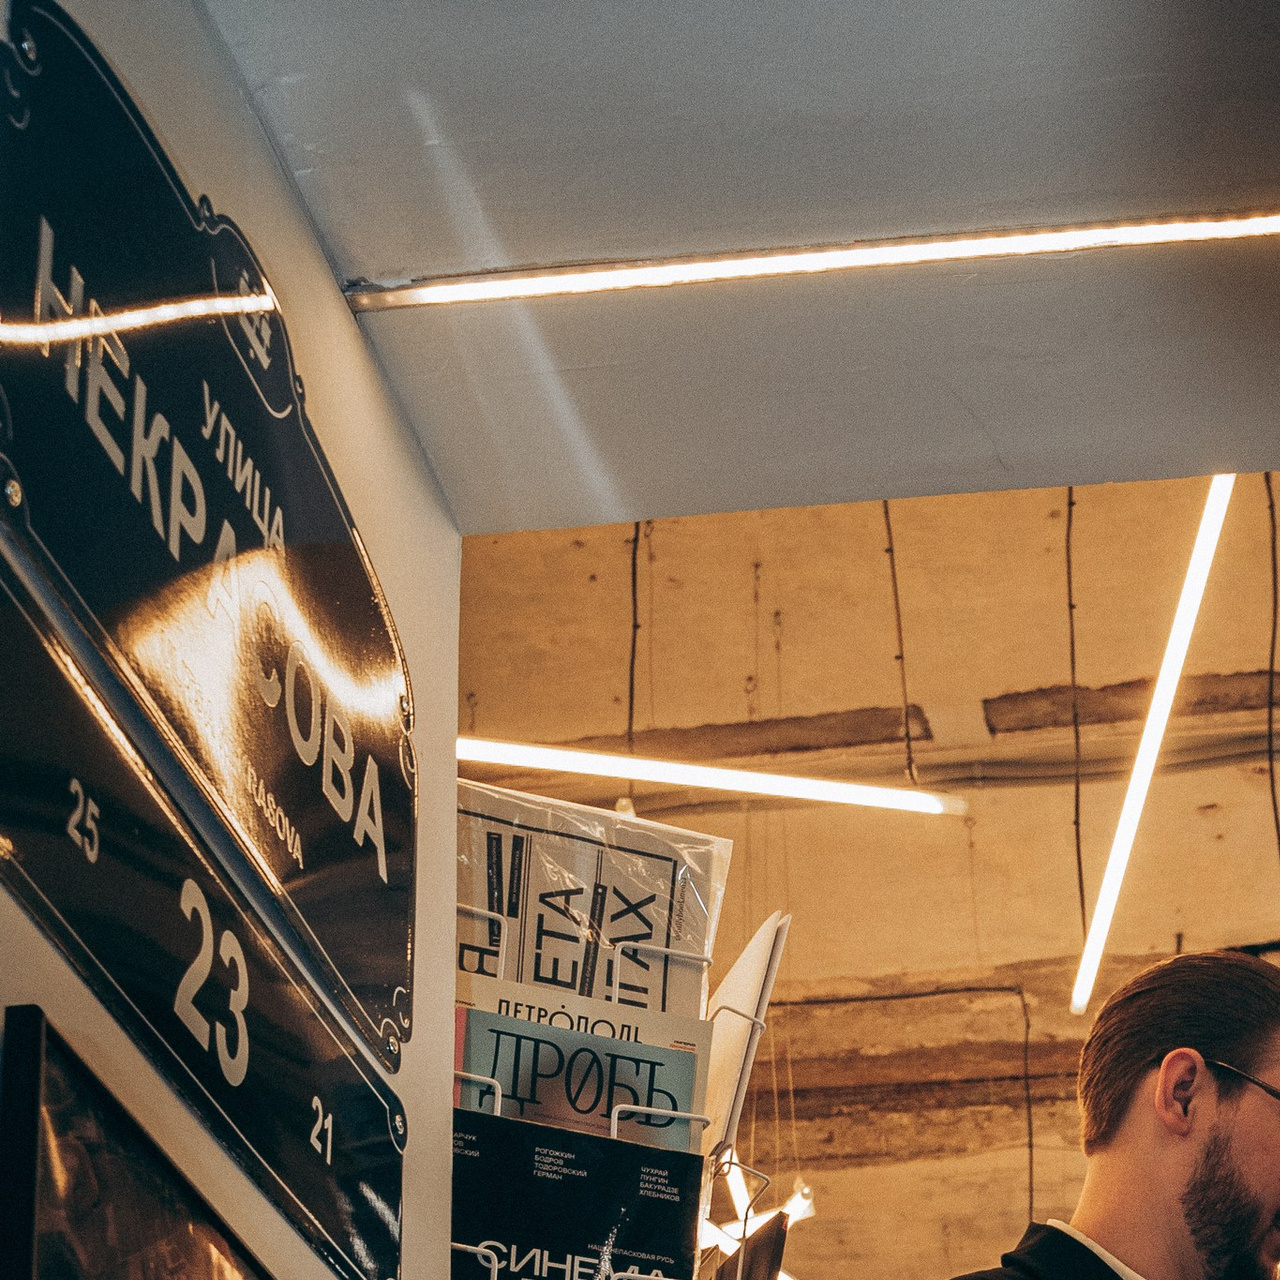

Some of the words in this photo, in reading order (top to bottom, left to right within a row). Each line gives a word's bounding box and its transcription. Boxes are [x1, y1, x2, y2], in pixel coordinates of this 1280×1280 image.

[202, 378, 286, 558] УЛИЦА
[34, 214, 389, 885] НЕКРАСОВА
[69, 778, 100, 864] 25
[533, 887, 584, 990] ЕТА
[173, 877, 250, 1087] 23
[309, 1095, 333, 1166] 21
[453, 1132, 478, 1142] АРЧУК
[453, 1140, 465, 1148] ОВ
[534, 1146, 576, 1160] РОГОЖКИН
[534, 1154, 564, 1166] БОДРОВ
[533, 1169, 563, 1181] ГЕРМАН
[534, 1162, 588, 1178] ТОДОРОВСКИЙ
[640, 1165, 669, 1177] ЧУХРАЙ
[639, 1182, 679, 1195] БАКУРАДЗЕ
